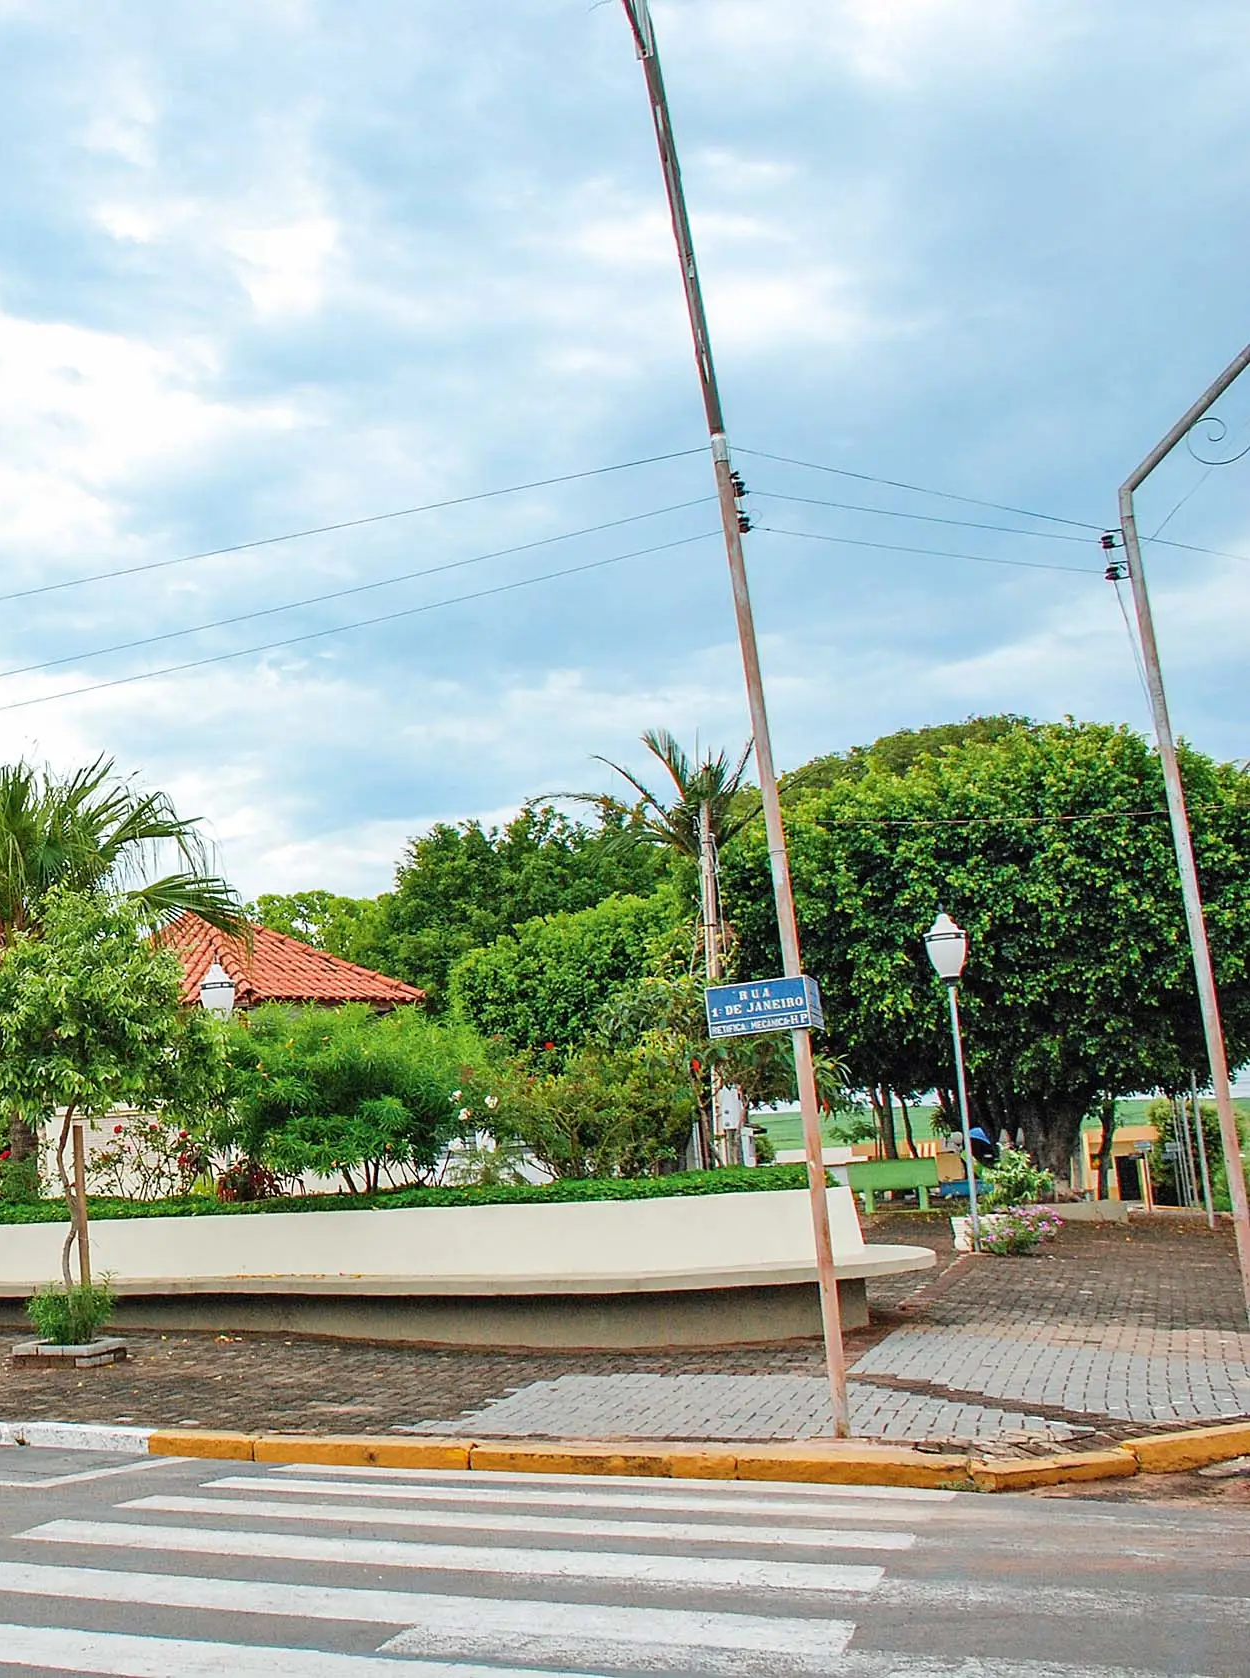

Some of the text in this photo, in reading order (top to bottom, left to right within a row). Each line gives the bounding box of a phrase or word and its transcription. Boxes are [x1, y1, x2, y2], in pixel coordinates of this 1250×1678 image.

[739, 988, 771, 1001] RUA
[724, 1004, 742, 1016] DE
[747, 996, 803, 1013] JANEIRO
